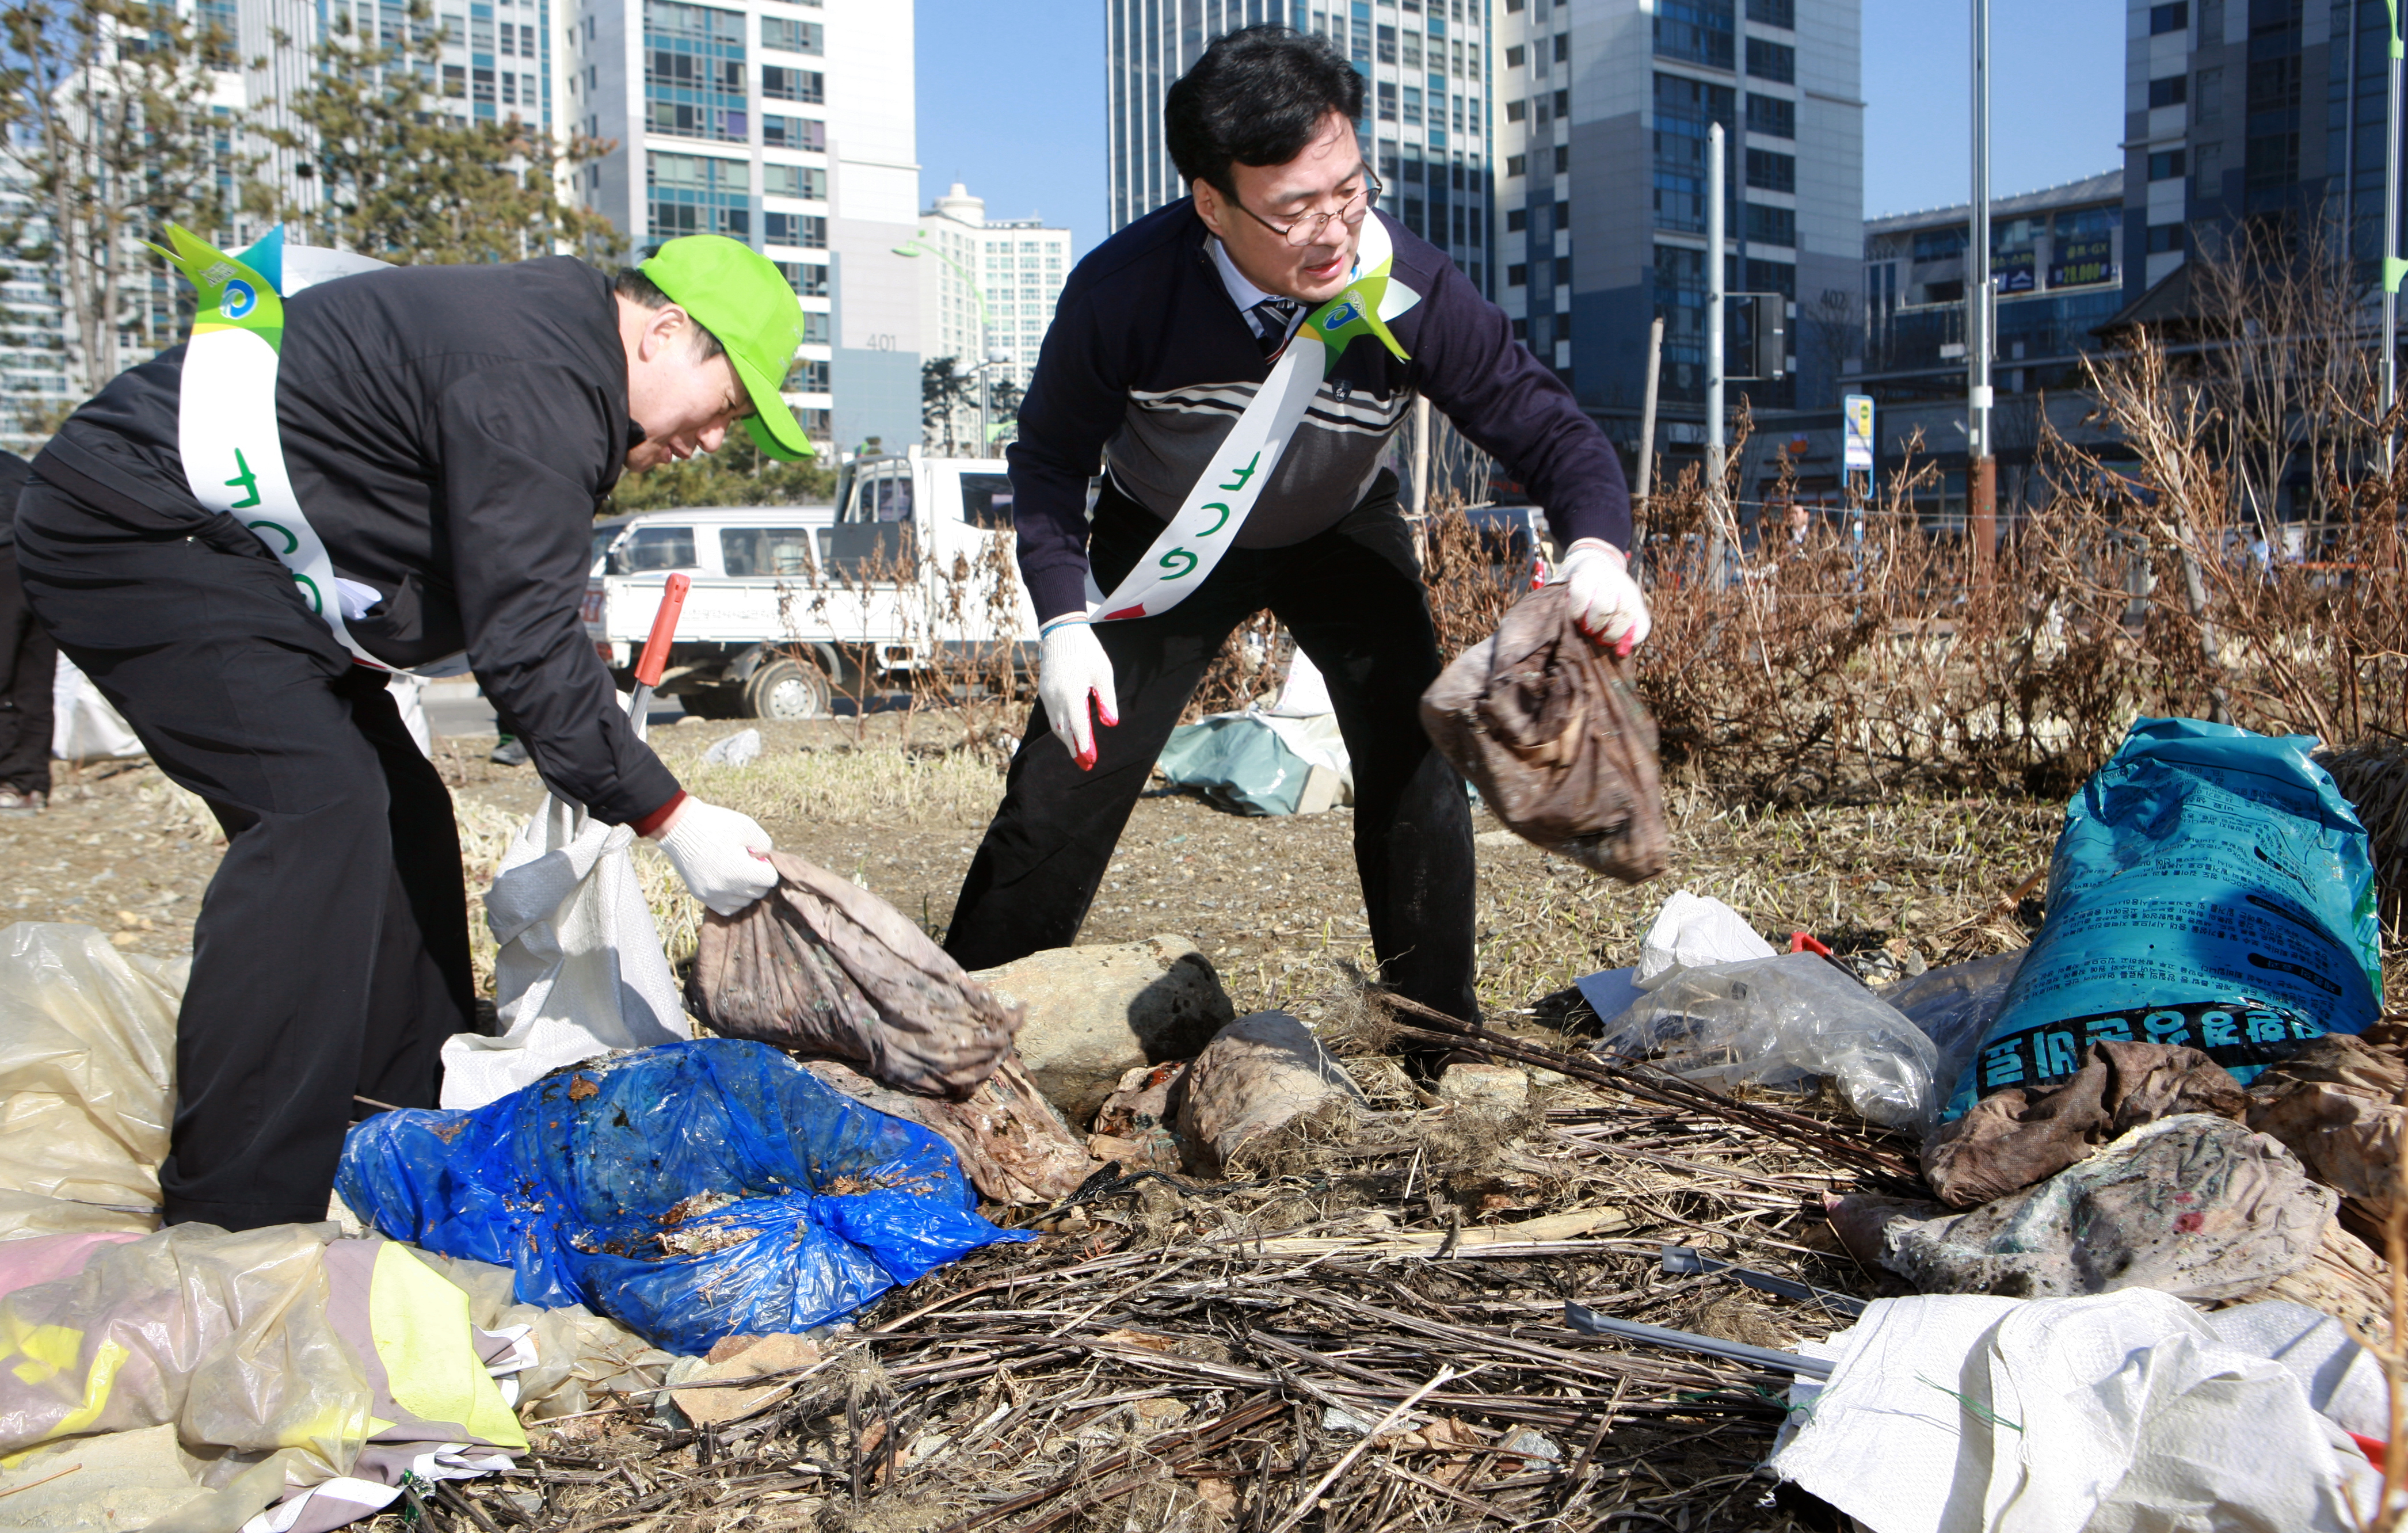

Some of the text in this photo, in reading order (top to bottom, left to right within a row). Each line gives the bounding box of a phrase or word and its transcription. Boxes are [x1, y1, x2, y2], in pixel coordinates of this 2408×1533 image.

[1820, 289, 1847, 310] 402
[867, 334, 896, 352] 401
[1159, 451, 1261, 580] GCF
[2142, 913, 2182, 922] 품질향상에
[2191, 925, 2225, 939] 통기성을
[2263, 943, 2288, 956] 퇴비는
[2084, 957, 2116, 966] 있으므로
[2120, 971, 2145, 979] 원료를
[2150, 971, 2175, 982] 양질의
[2199, 962, 2243, 979] 퇴비입니다.
